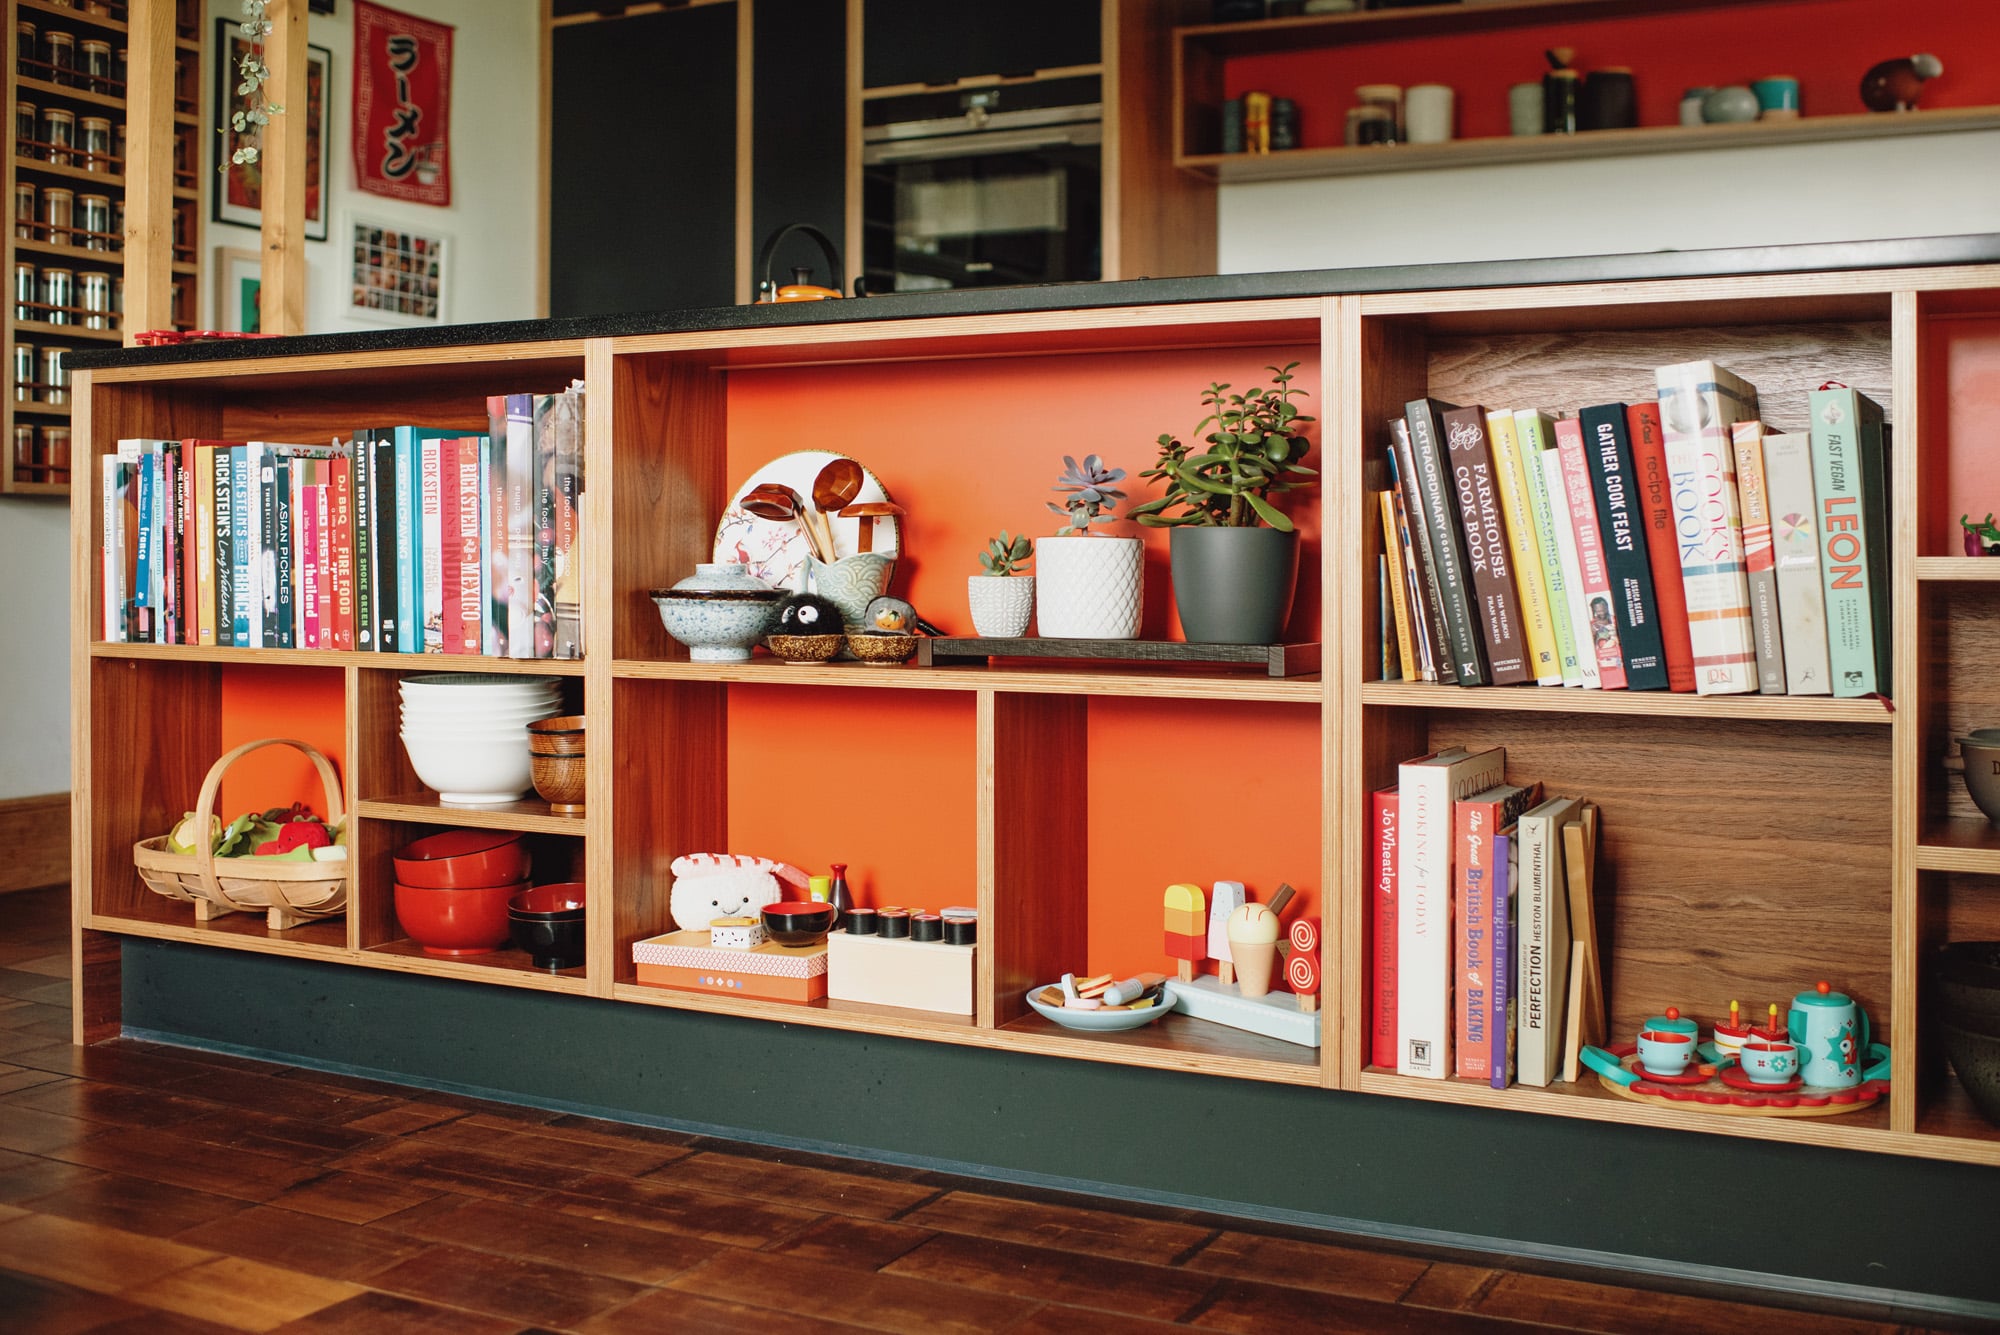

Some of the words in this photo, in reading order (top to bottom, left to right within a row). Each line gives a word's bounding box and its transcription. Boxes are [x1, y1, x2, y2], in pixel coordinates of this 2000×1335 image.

[386, 36, 418, 178] ラーメン
[357, 441, 365, 482] MARTIN
[423, 449, 437, 478] RICK
[446, 449, 455, 481] RICK
[1597, 423, 1619, 472] GATHER
[1828, 434, 1842, 459] FAST
[216, 455, 230, 486] RICK
[235, 461, 247, 489] RICK
[338, 475, 346, 492] DJ
[398, 454, 407, 506] MEXICAN
[460, 463, 477, 495] RICK
[564, 477, 572, 494] the
[1560, 434, 1593, 520] SWEET
[1830, 461, 1846, 491] VEGAN
[319, 484, 328, 527] MISO
[338, 496, 346, 525] BBQ
[358, 486, 366, 527] NORDIN
[424, 481, 437, 515] STEIN
[446, 484, 457, 538] STEIN'S
[496, 487, 504, 503] the
[542, 488, 550, 504] the
[564, 495, 572, 518] food
[1527, 427, 1538, 452] THE
[1537, 503, 1558, 567] ROASTING
[1551, 570, 1562, 592] TIN
[1605, 475, 1624, 509] COOK
[1646, 456, 1662, 504] recipe
[1654, 509, 1668, 530] file
[1698, 453, 1732, 562] COOK'S
[216, 488, 230, 537] STEIN'S
[236, 491, 248, 536] STEIN'S
[279, 502, 288, 543] ASIAN
[461, 496, 478, 537] STEIN
[542, 507, 550, 529] food
[564, 521, 572, 531] of
[1456, 466, 1474, 519] COOK
[1465, 520, 1486, 574] BOOK
[1473, 463, 1506, 578] FARMHOUSE
[1612, 512, 1633, 551] FEAST
[1672, 471, 1705, 562] BOOK
[138, 527, 149, 560] france
[217, 540, 228, 567] Long
[319, 530, 329, 574] TASTY
[399, 508, 408, 559] CRAVING
[497, 531, 504, 541] of
[542, 532, 550, 542] of
[1416, 421, 1447, 532] EXTRAORDINARY
[1440, 533, 1456, 588] COOKBOOK
[1452, 594, 1463, 626] STEFAN
[1458, 627, 1469, 653] GATES
[1519, 532, 1529, 552] TIN
[1579, 525, 1597, 547] LEVI
[1824, 496, 1863, 590] LEON
[338, 547, 349, 576] FIRE
[443, 543, 462, 601] INDIA
[541, 545, 550, 565] italy
[1582, 550, 1602, 584] ROOTS
[234, 565, 248, 619] FRANCE
[280, 547, 288, 604] PICKLES
[304, 563, 317, 618] thailand
[461, 562, 480, 621] MEXICO
[1758, 582, 1766, 594] ICE
[219, 568, 232, 628] Weekends
[339, 580, 350, 615] FOOD
[1425, 566, 1439, 613] SWEET
[1434, 617, 1447, 656] HOME
[1487, 596, 1496, 617] FRAN
[1630, 579, 1640, 602] JESSICA
[1635, 602, 1644, 624] SEATON
[1759, 595, 1769, 617] CREAM
[1490, 618, 1500, 644] WARDE
[1499, 612, 1510, 639] WILSON
[1761, 619, 1772, 659] COOKBOOK
[1462, 663, 1476, 676] K
[1708, 669, 1732, 682] DK
[1453, 767, 1500, 802] COOKING
[1382, 808, 1395, 825] Jo
[1415, 784, 1428, 863] COOKING
[1469, 811, 1482, 831] The
[1379, 826, 1396, 894] Wheatley
[1469, 835, 1482, 865] Great
[1533, 841, 1541, 902] BLUMENTHAL
[1415, 884, 1428, 938] TODAY
[1467, 868, 1484, 924] British
[1382, 910, 1394, 963] Passion
[1493, 896, 1504, 950] magical
[1533, 905, 1541, 942] HESTON
[1467, 928, 1484, 969] Book
[1382, 966, 1395, 985] for
[1468, 972, 1483, 986] of
[1495, 957, 1506, 1012] muffins
[1530, 945, 1541, 1029] PERFECTION
[1379, 989, 1395, 1037] Baking
[1467, 988, 1484, 1044] BAKING
